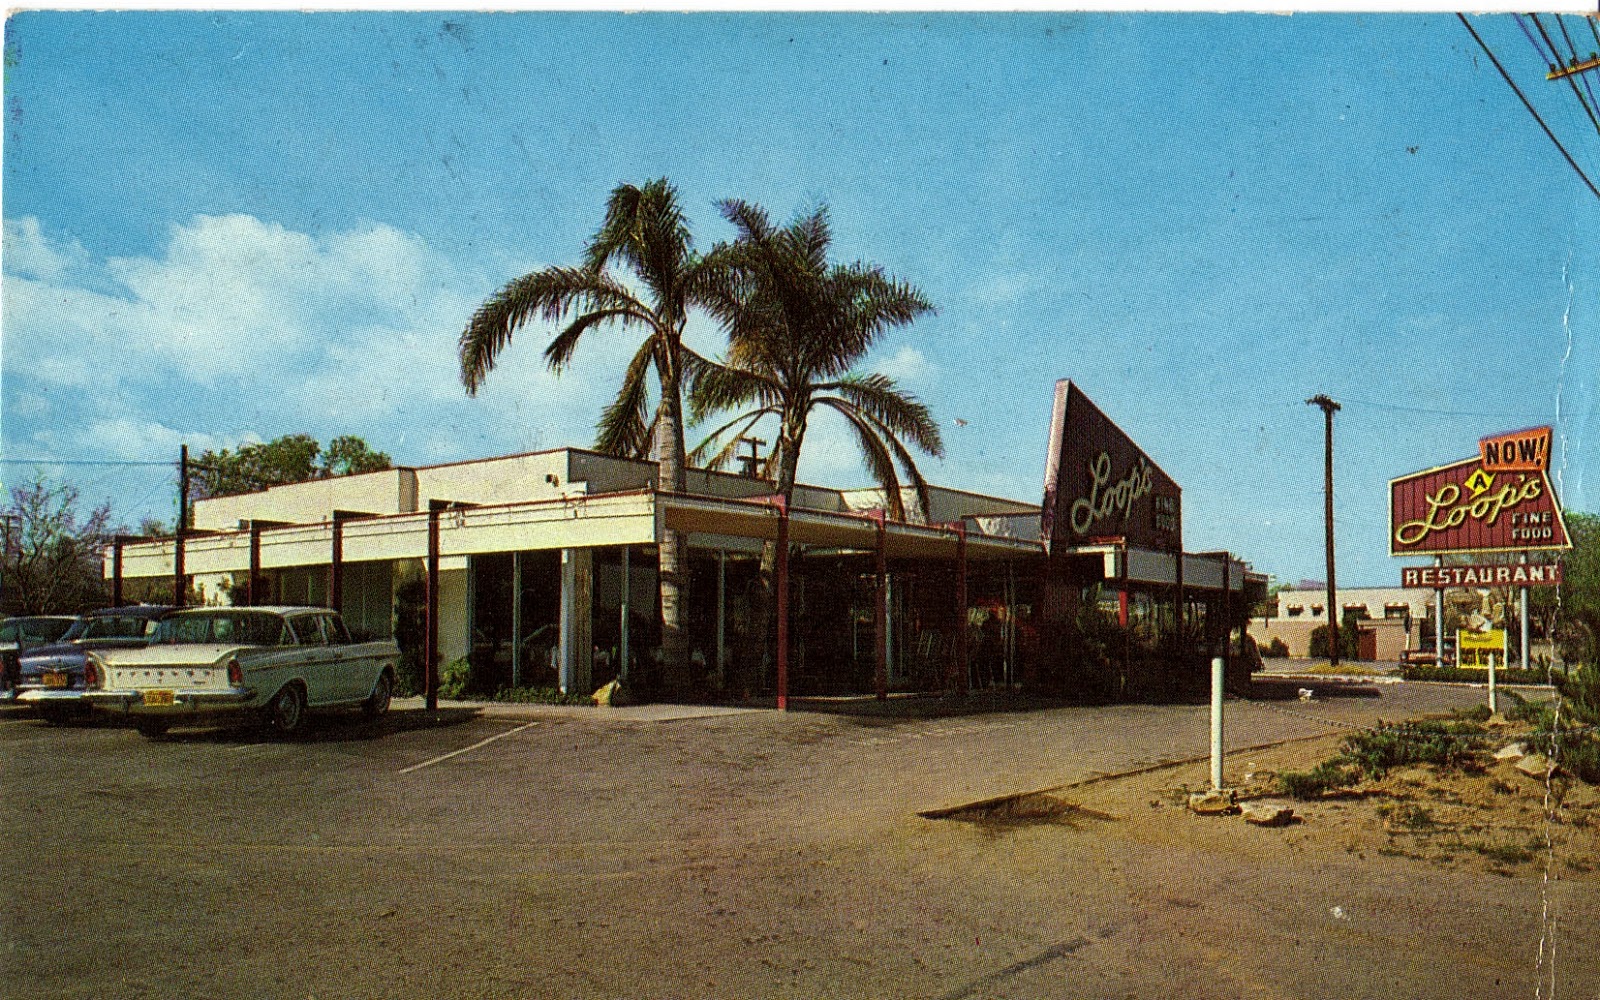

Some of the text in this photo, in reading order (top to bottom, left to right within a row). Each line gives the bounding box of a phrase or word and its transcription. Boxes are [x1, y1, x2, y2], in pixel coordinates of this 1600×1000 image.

[1485, 435, 1546, 466] NOW!
[1473, 473, 1488, 491] A
[1071, 452, 1153, 533] Loop's
[1395, 474, 1542, 545] Loop's
[1512, 511, 1552, 524] FINE
[1512, 527, 1552, 539] FOOD
[1405, 565, 1557, 585] RESTAURANT
